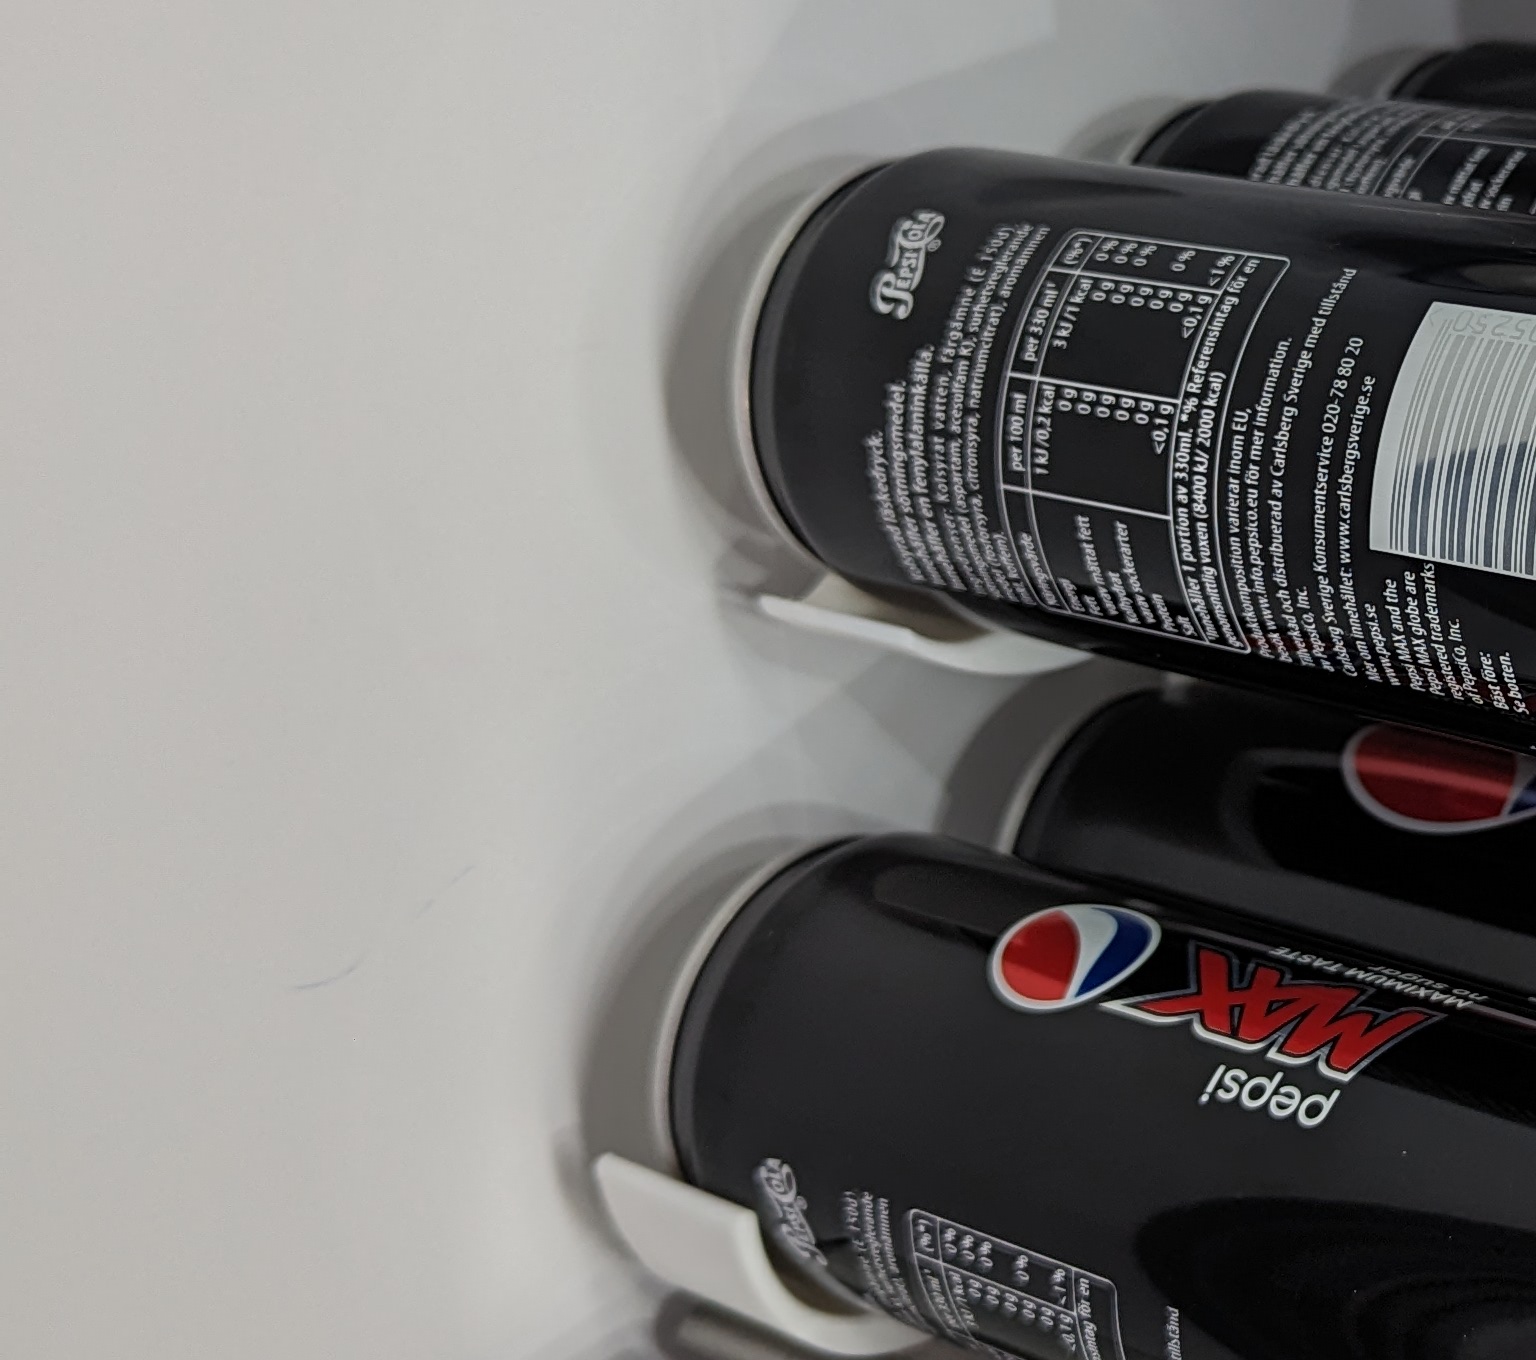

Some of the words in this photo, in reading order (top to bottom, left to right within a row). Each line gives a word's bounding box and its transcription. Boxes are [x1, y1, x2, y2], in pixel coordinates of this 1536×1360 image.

[1227, 276, 1248, 295] för
[1244, 258, 1260, 274] en
[1072, 278, 1094, 303] kcal
[1318, 268, 1357, 316] tillstånd
[1028, 310, 1049, 336] 330
[1304, 317, 1327, 348] med
[1025, 340, 1039, 361] per
[1189, 296, 1241, 393] Referensintag
[1349, 337, 1364, 356] 20
[1202, 371, 1226, 403] kcal)
[1253, 337, 1293, 427] information.
[1283, 350, 1312, 403] Sverige
[1337, 358, 1356, 378] 80
[1013, 393, 1027, 413] ml
[1038, 385, 1056, 413] kcal
[1322, 378, 1348, 436] 020-78
[1010, 417, 1024, 441] 100
[1197, 406, 1215, 448] 2000
[1232, 408, 1252, 431] EU,
[1009, 450, 1025, 471] per
[1174, 429, 1193, 481] 330ml.
[1227, 431, 1245, 475] inom
[1250, 426, 1265, 462] mer
[1270, 406, 1299, 476] Carlsberg
[1244, 466, 1260, 486] för
[1270, 479, 1283, 497] av
[1337, 375, 1376, 564] www.carlsbergsverige.se
[1175, 488, 1188, 503] av
[1191, 476, 1208, 519] (8400
[1226, 477, 1241, 533] varierar
[1312, 437, 1335, 574] Konsumentservice
[1177, 511, 1196, 564] portion
[1195, 519, 1211, 564] vuxen
[1267, 499, 1288, 588] distribuerad
[1245, 487, 1278, 632] www.info.pepsico.eu
[1275, 591, 1294, 614] och
[1317, 575, 1337, 625] Sverige
[1383, 579, 1397, 601] the
[1404, 571, 1416, 594] are
[1386, 604, 1403, 633] and
[1407, 596, 1428, 636] globe
[1421, 562, 1444, 647] trademarks
[1365, 603, 1401, 686] www.pepsi.se
[1448, 618, 1462, 642] Inc.
[1332, 626, 1358, 677] Carlsberg
[1390, 634, 1412, 667] MAX
[1268, 945, 1343, 975] TASTE
[1341, 966, 1474, 1009] MAXIMUM
[1100, 942, 1448, 1081] MAX
[1198, 1063, 1342, 1129] pepsi
